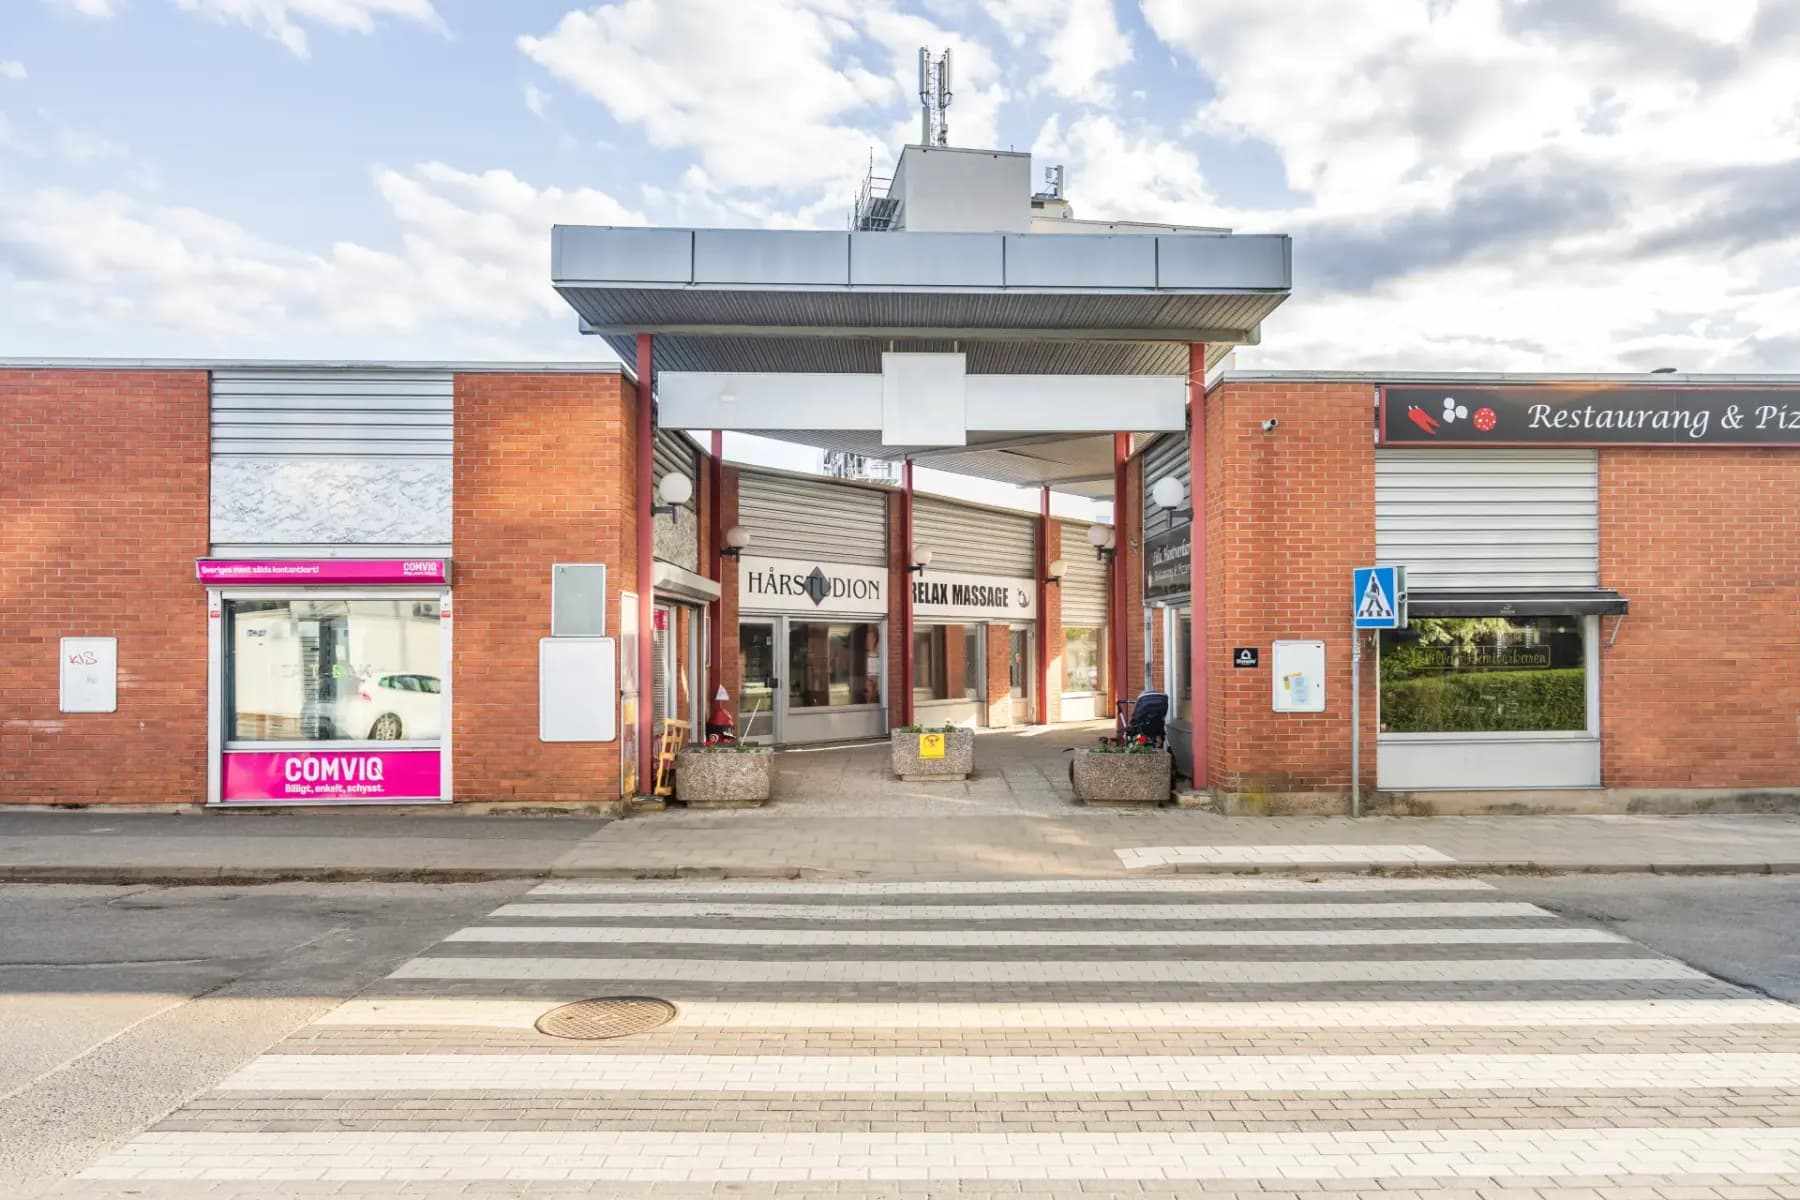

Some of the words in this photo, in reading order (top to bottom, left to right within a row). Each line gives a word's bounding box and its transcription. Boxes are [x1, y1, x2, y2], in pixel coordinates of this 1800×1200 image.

[1528, 404, 1710, 438] Restaurang
[1721, 404, 1745, 430] &
[1755, 404, 1800, 430] Piz
[403, 562, 437, 571] COMVIQ
[748, 566, 881, 600] HÅRSTUDION
[952, 584, 1009, 608] MASSAGE
[285, 757, 384, 782] COMVIQ
[285, 784, 314, 795] Billigt,
[315, 784, 345, 794] enkelt,
[347, 784, 385, 794] schysst.
